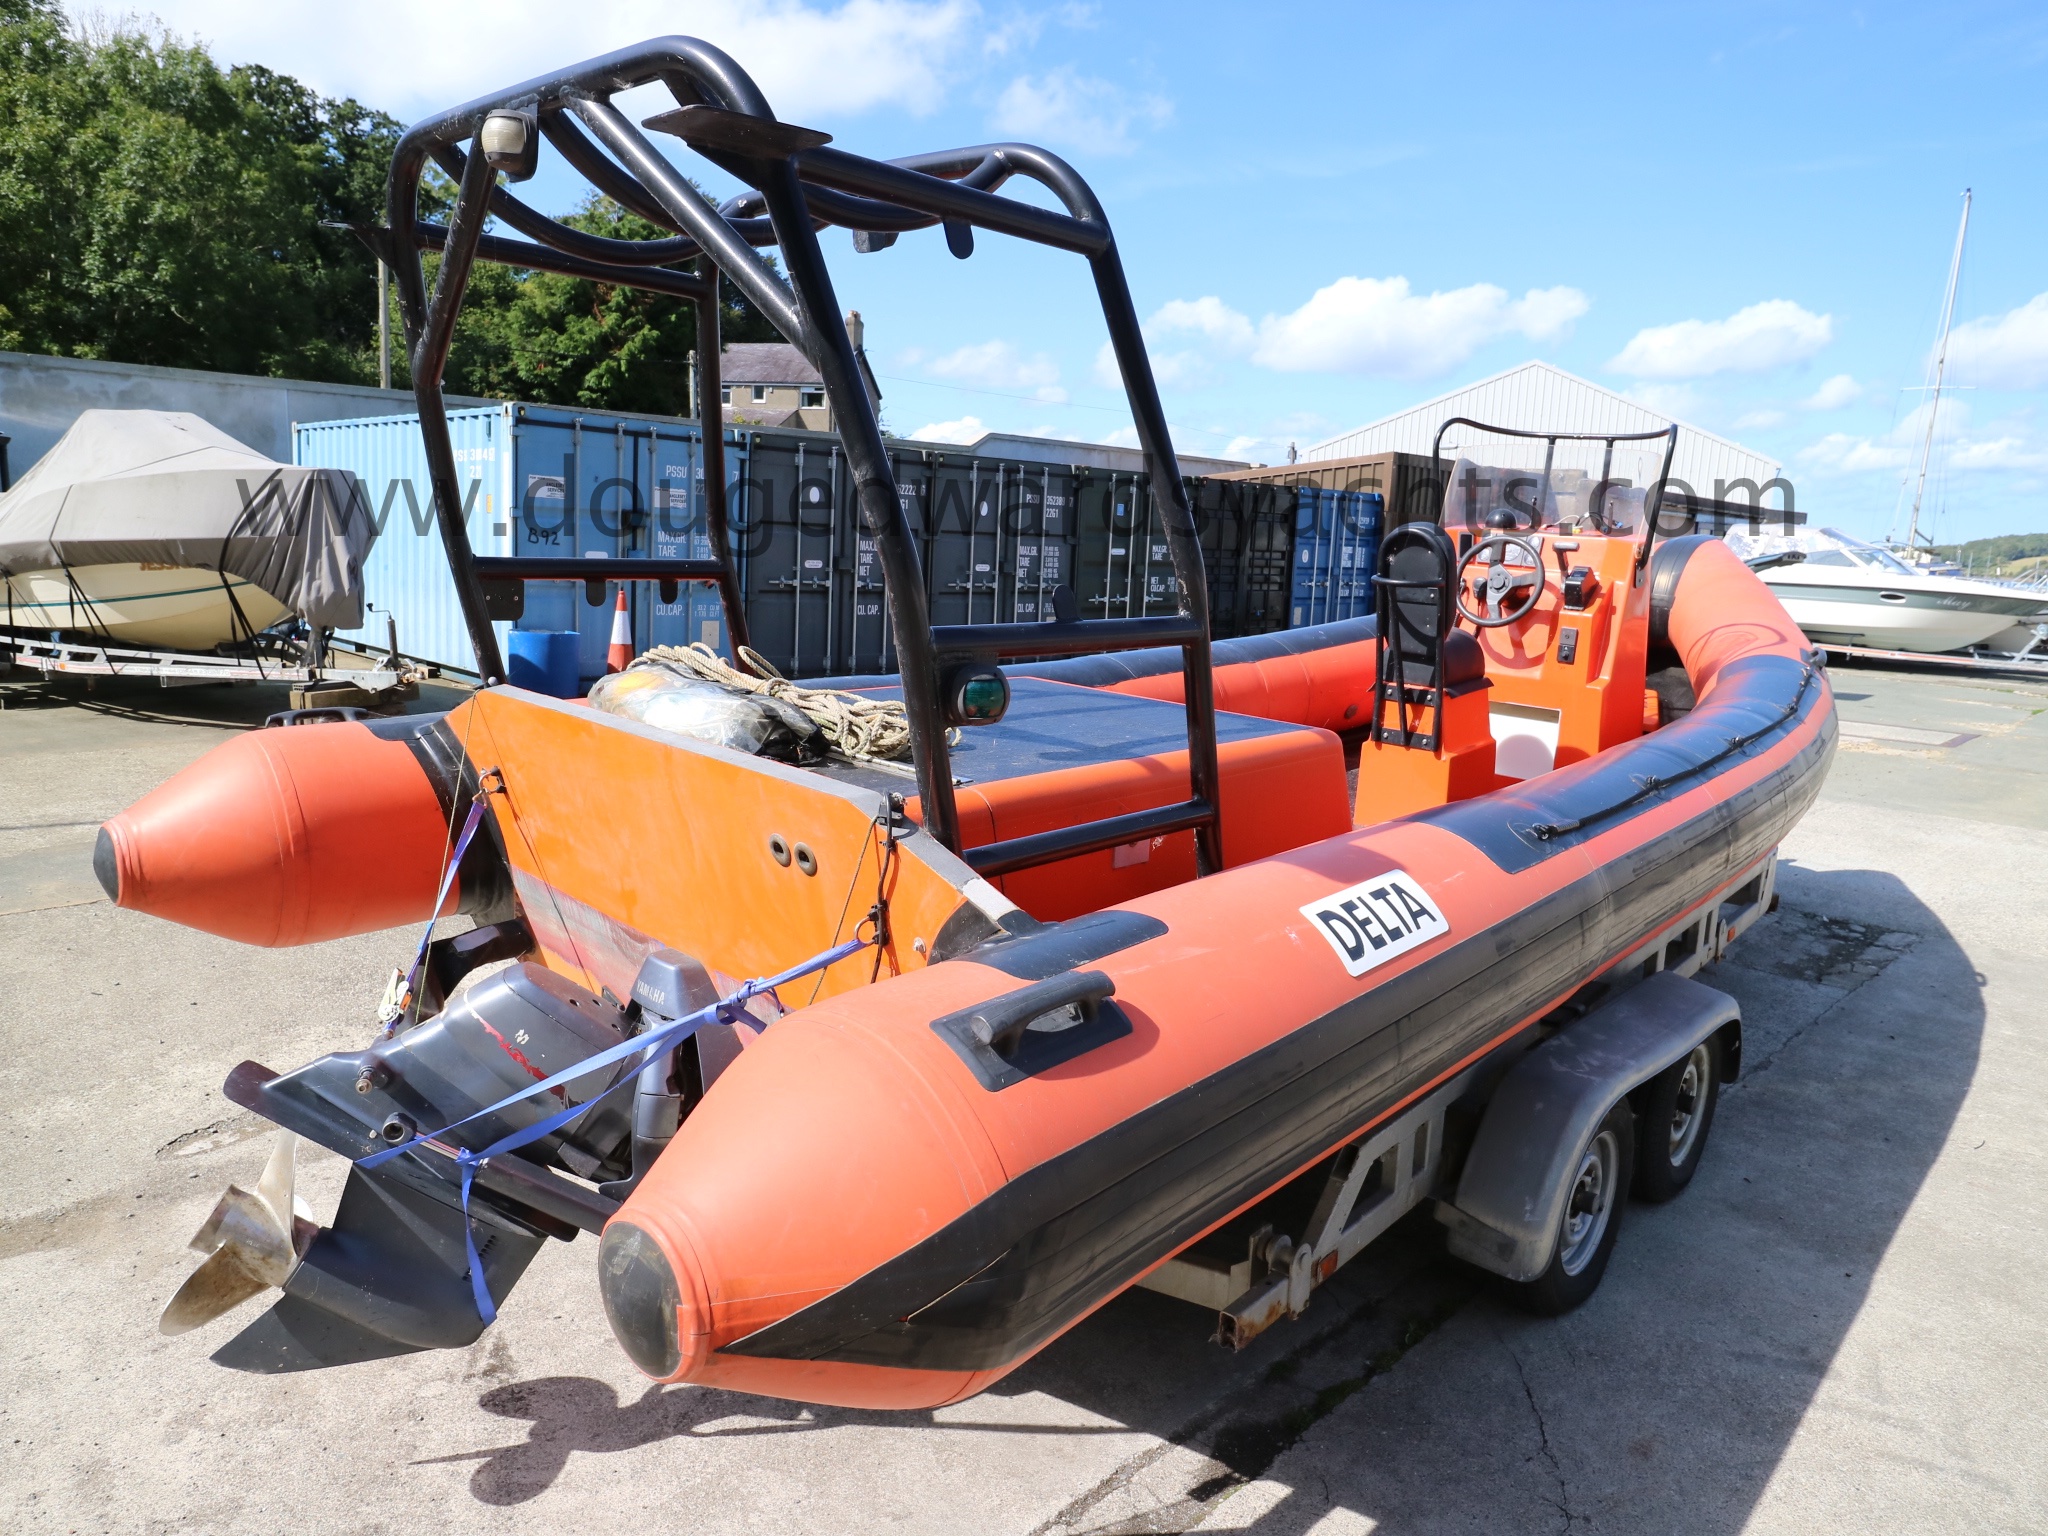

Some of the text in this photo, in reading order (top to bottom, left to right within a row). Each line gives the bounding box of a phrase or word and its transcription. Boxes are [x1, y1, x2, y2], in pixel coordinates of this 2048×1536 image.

[666, 465, 688, 478] PSSU
[897, 484, 916, 495] 52222
[528, 527, 560, 546] B92
[658, 545, 676, 557] TARE
[860, 553, 873, 563] TARE
[859, 566, 870, 576] NET
[1315, 882, 1437, 963] DELTA
[636, 979, 665, 1005] YAMAHA
